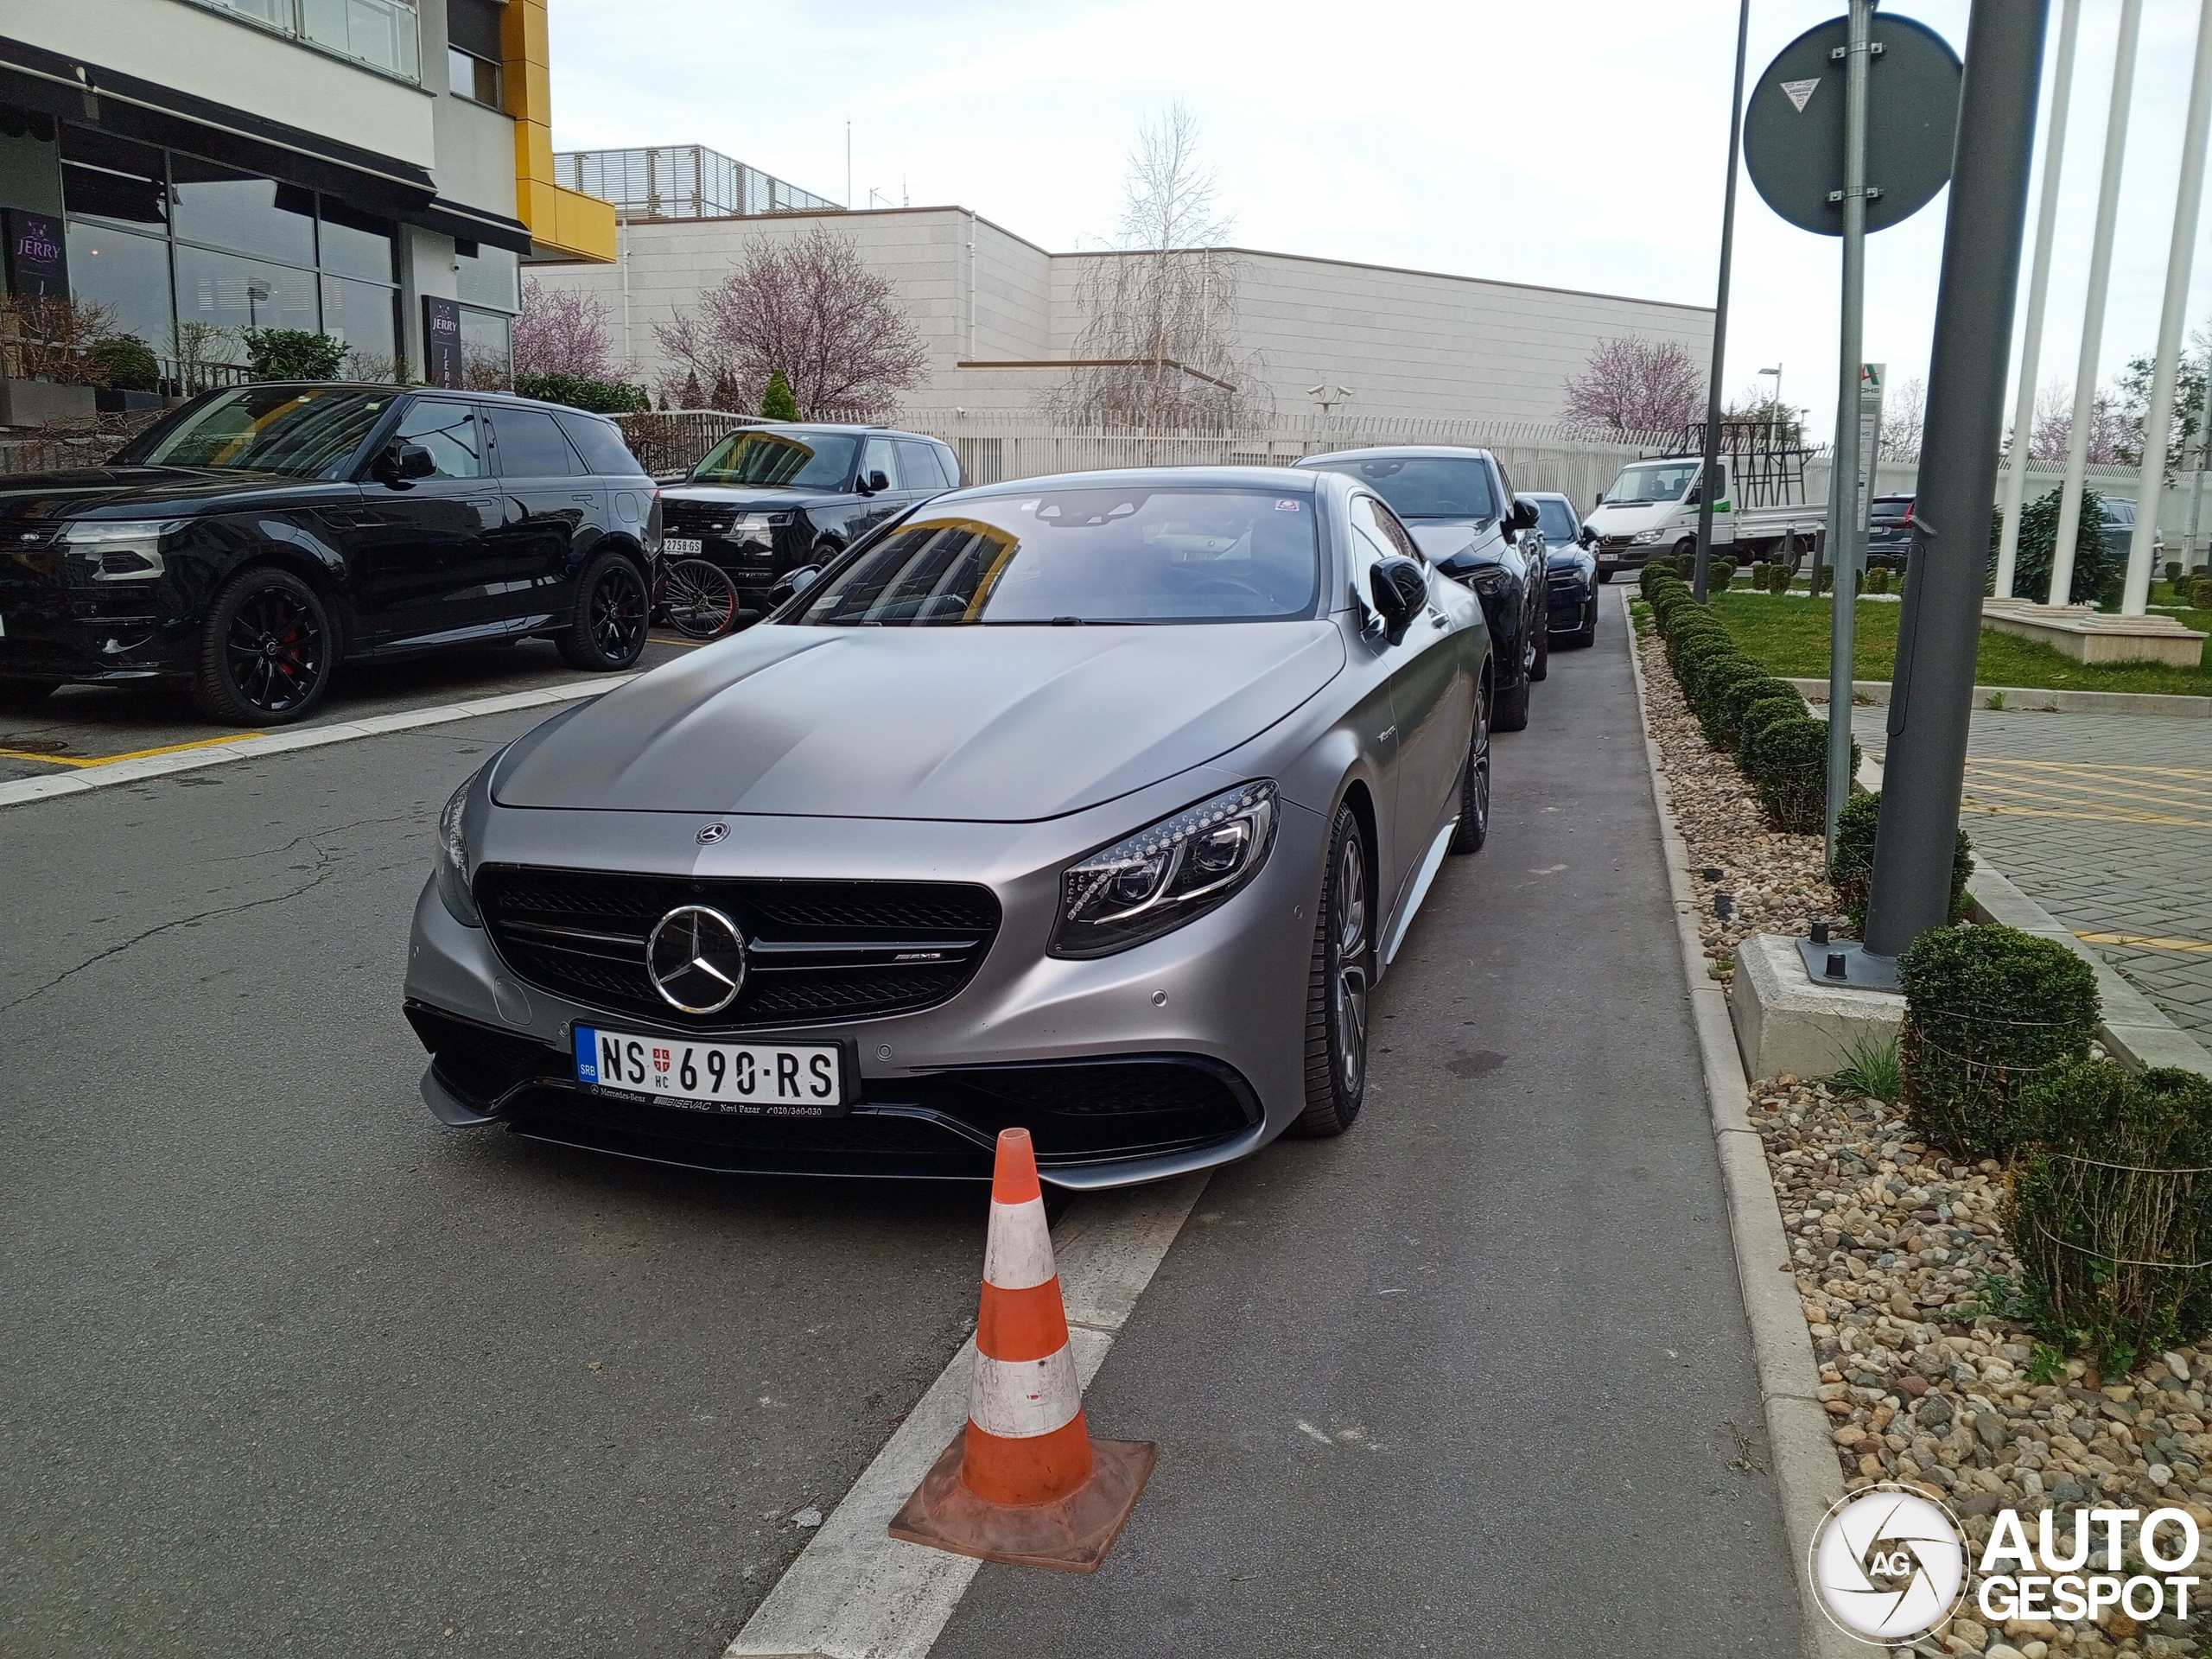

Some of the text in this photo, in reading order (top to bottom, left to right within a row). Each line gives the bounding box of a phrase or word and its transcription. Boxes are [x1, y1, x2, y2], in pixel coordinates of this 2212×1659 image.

[17, 238, 60, 259] JERRY
[433, 317, 458, 332] JERRY
[580, 1064, 597, 1077] SRB
[601, 1037, 646, 1085] NS
[600, 1087, 646, 1103] Mercedes-Benz
[720, 1103, 737, 1113] Novi
[738, 1105, 761, 1115] Pazar
[772, 1106, 823, 1116] 020/360-030
